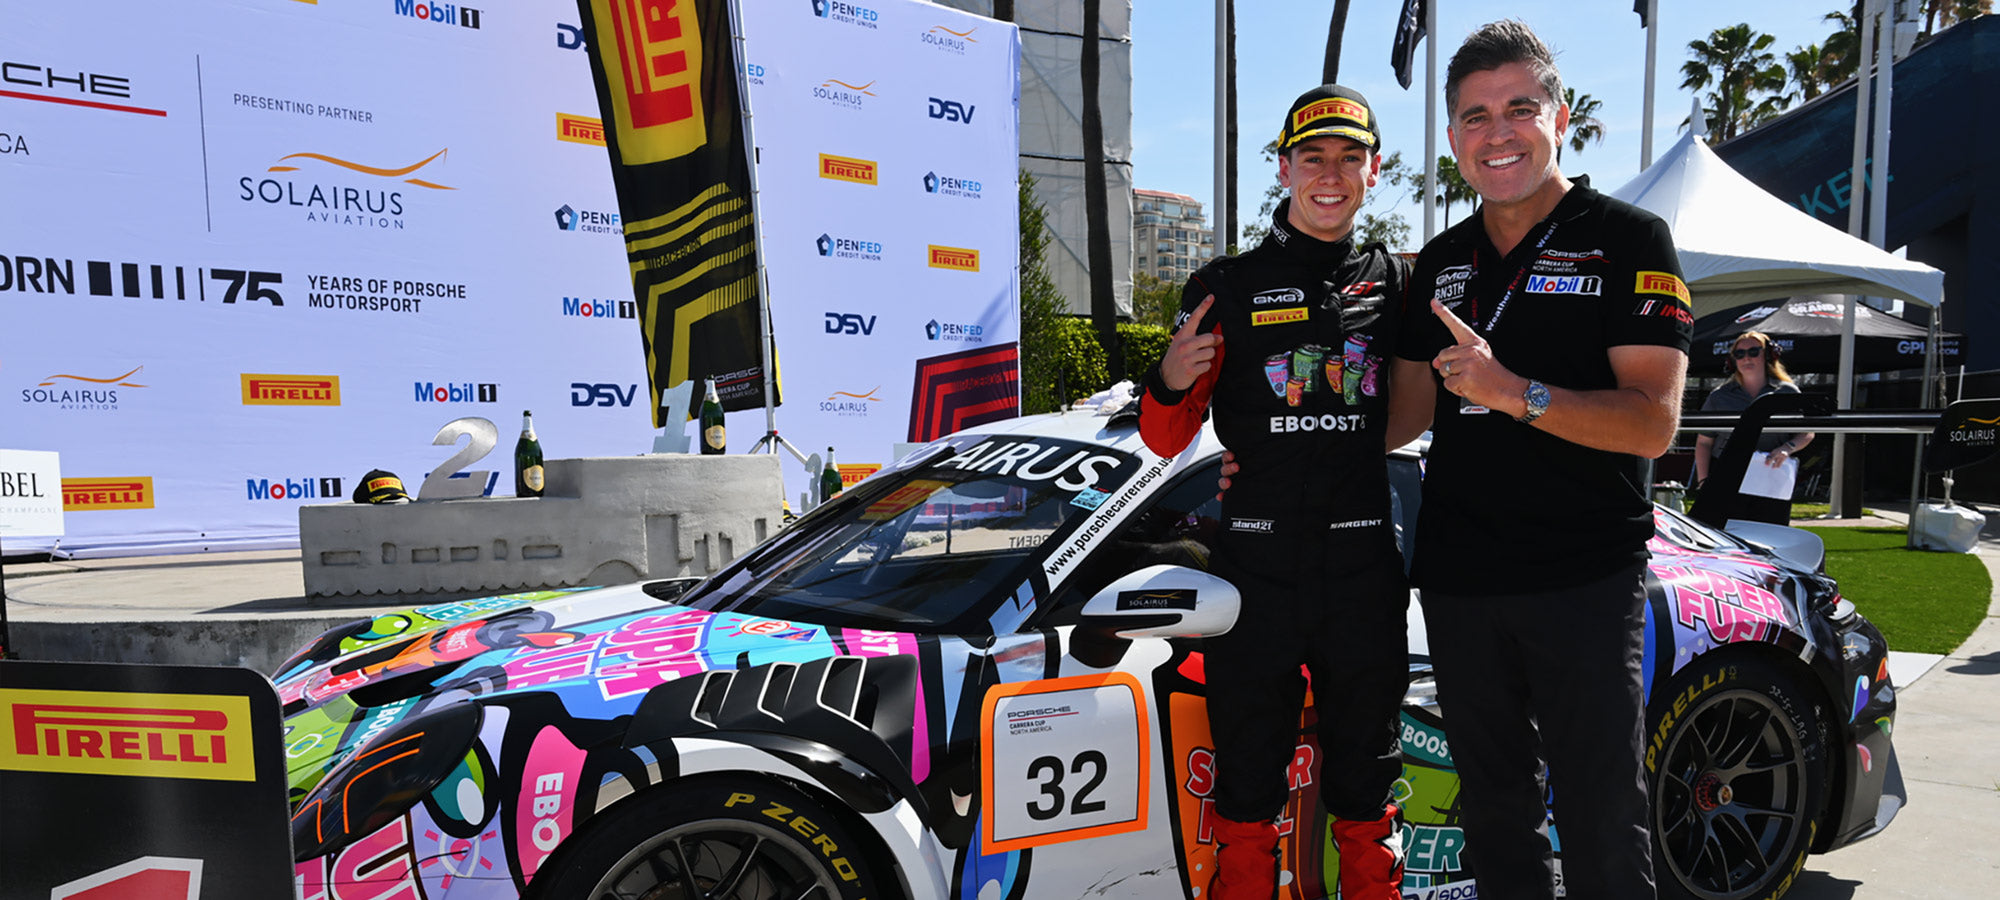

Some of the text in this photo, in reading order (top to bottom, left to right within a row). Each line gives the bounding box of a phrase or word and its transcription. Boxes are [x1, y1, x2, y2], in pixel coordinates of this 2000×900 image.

[395, 0, 456, 25] Mobil
[832, 4, 878, 21] PENFED
[832, 14, 878, 29] CREDIT UNION
[921, 32, 965, 51] SOLAIRUS
[814, 87, 862, 105] SOLAIRUS
[233, 93, 373, 123] PRESENTING PARTNER
[929, 97, 975, 124] DSV
[1298, 100, 1363, 125] PIRELLI
[824, 158, 873, 180] PIRELLI
[941, 177, 982, 192] PENFED
[239, 176, 403, 216] SOLAIRUS
[307, 211, 404, 230] AVIATION
[581, 210, 619, 225] PENF
[581, 224, 610, 235] CREDIT
[836, 239, 881, 254] PENFED
[836, 251, 882, 262] CREDIT UNION
[931, 249, 975, 267] PIRELLI
[211, 268, 284, 306] 75
[307, 275, 466, 299] YEARS OF PORSCHE
[1527, 276, 1580, 292] Mobil
[308, 293, 421, 313] MOTORSPORT
[563, 297, 615, 318] Mobil
[1253, 293, 1297, 305] GMG
[825, 312, 876, 335] DSV
[1256, 309, 1304, 323] PIRELLI
[943, 323, 983, 336] PENFED
[22, 389, 118, 404] SOLAIRUS
[250, 380, 332, 400] PIRELLI
[414, 382, 473, 402] Mobil
[571, 383, 637, 407] DSV
[820, 401, 867, 412] SOLAIRUS
[1270, 414, 1360, 433] EBOOST
[1950, 429, 1995, 442] SOLAIRUS
[418, 416, 498, 500] 2
[247, 478, 315, 500] Mobil
[1329, 519, 1383, 530] SARGENT
[1007, 705, 1071, 718] PORSCHE
[1645, 667, 1726, 773] PIRELLI
[12, 703, 228, 763] PIRELLI
[1009, 719, 1046, 730] CARRERA CUP
[1010, 725, 1053, 736] NORTH AMERICA
[1026, 750, 1108, 821] 32
[724, 792, 859, 881] P ZERO
